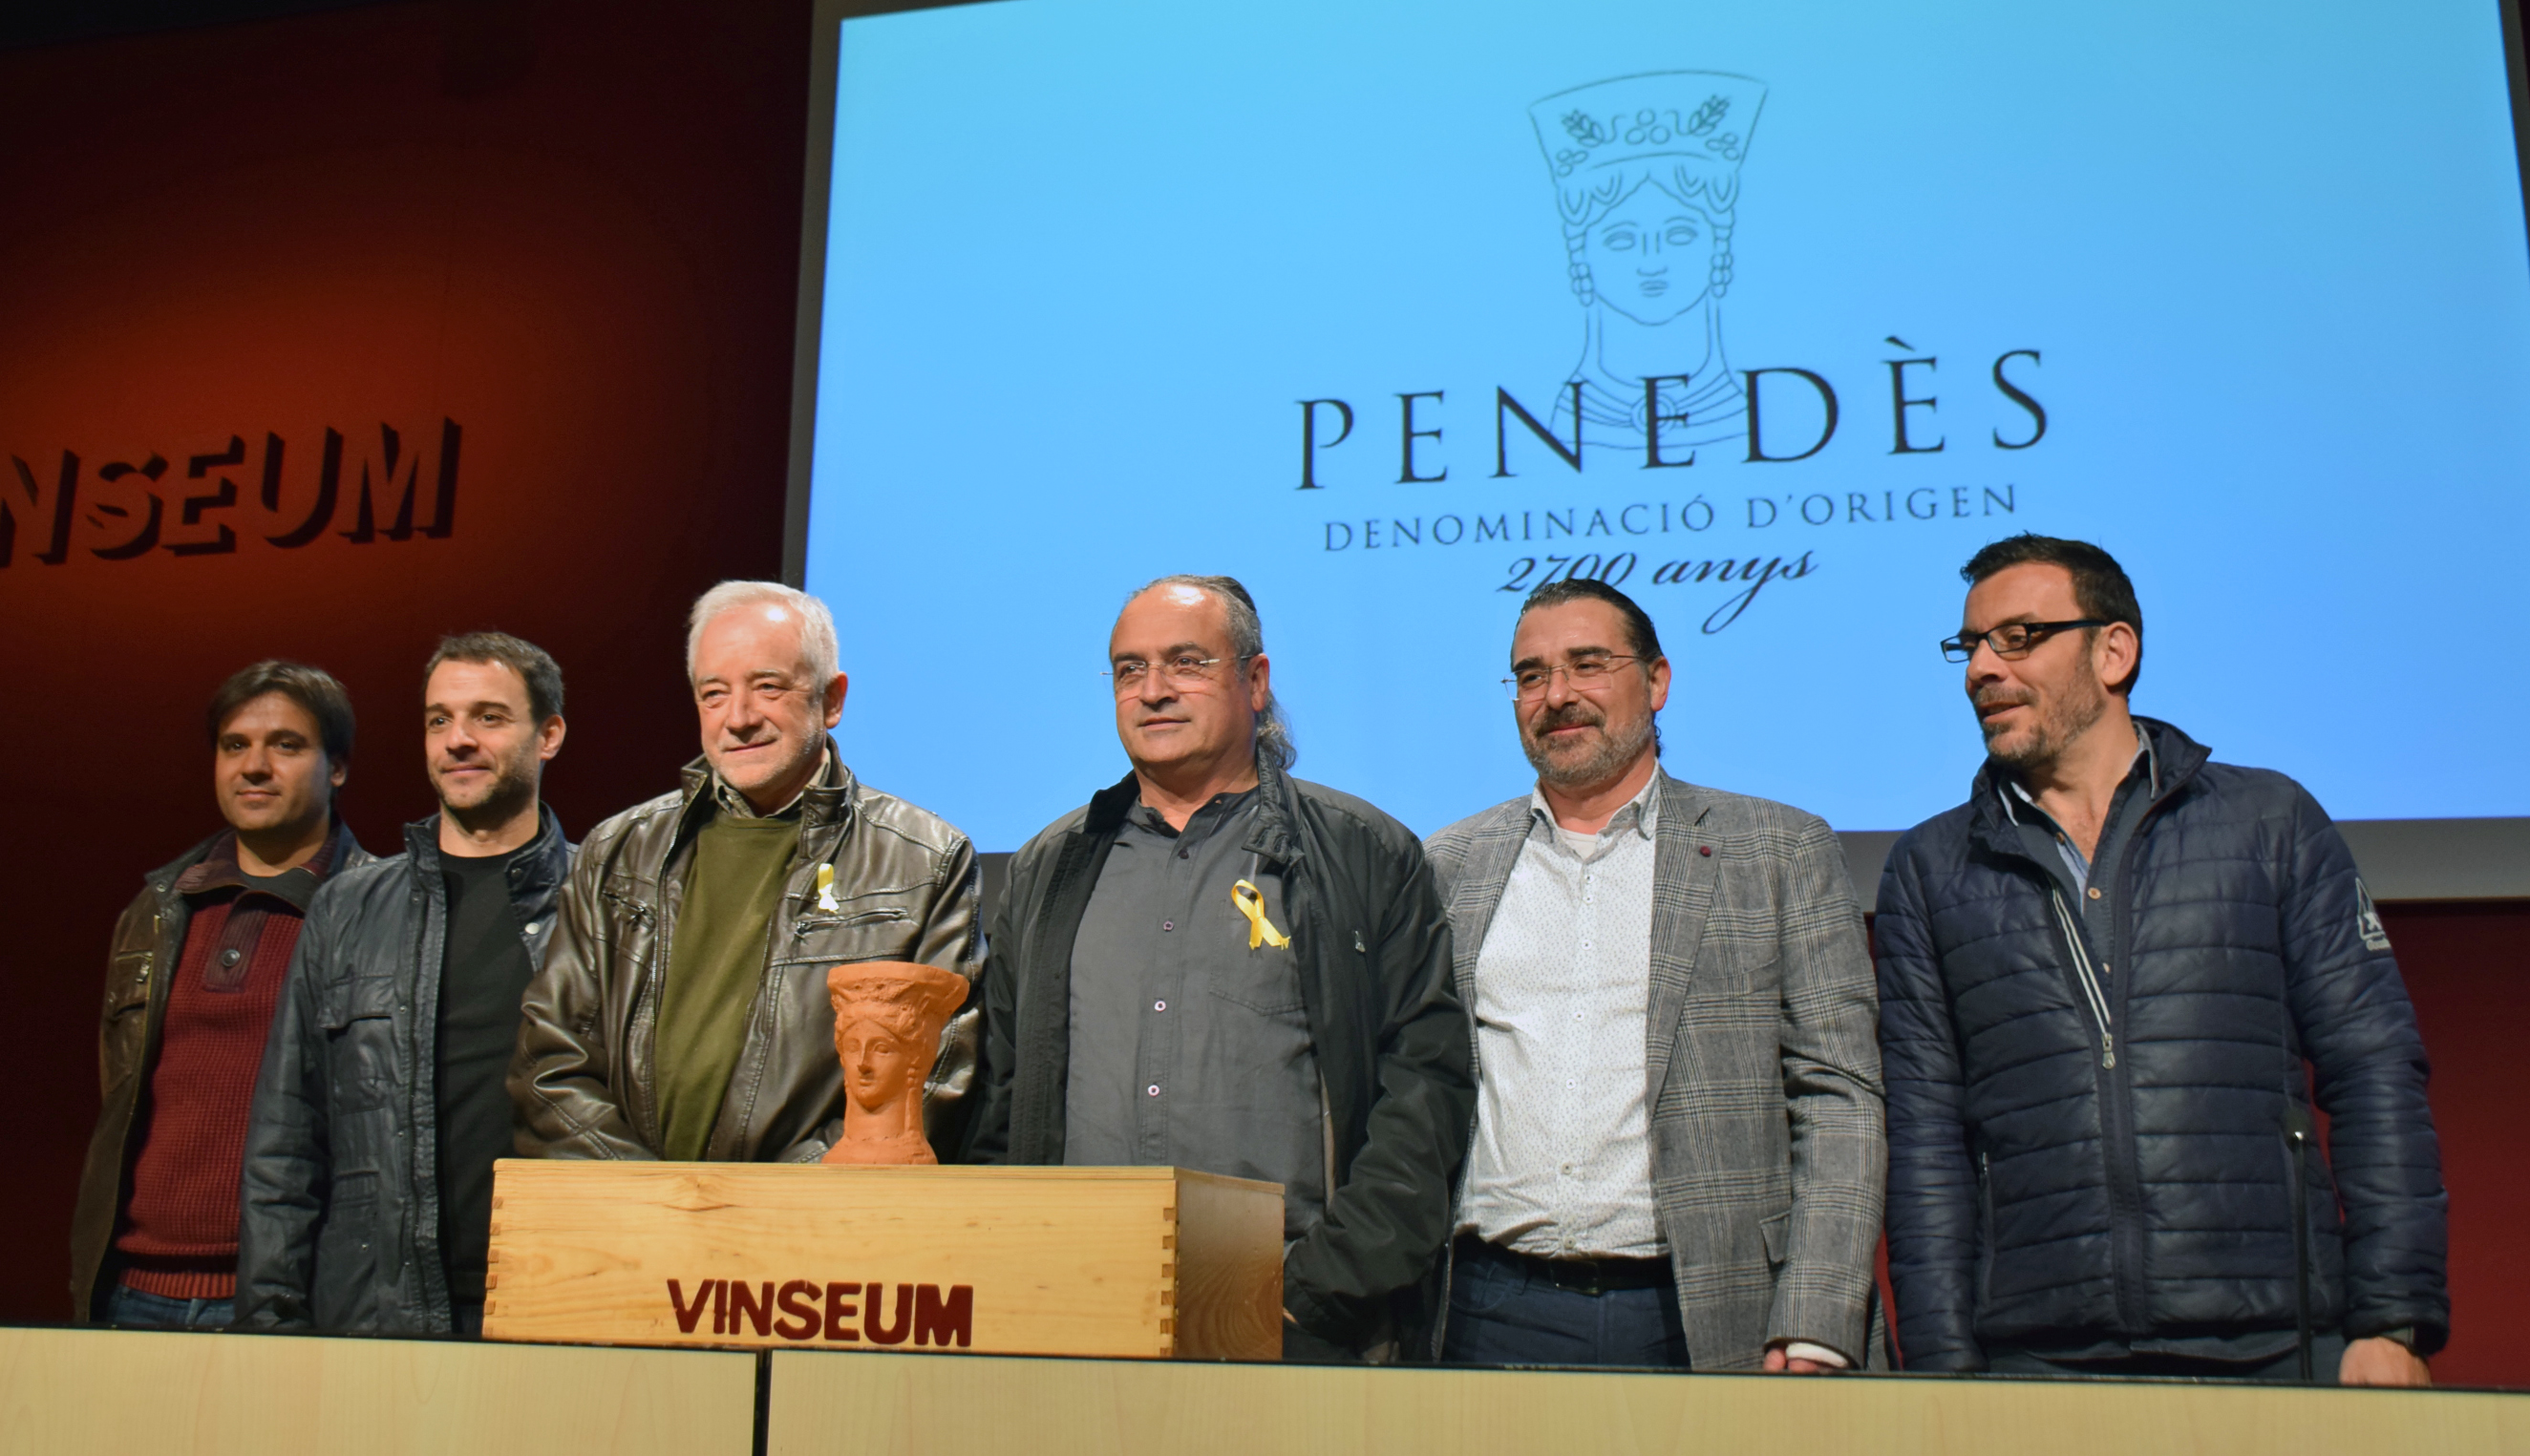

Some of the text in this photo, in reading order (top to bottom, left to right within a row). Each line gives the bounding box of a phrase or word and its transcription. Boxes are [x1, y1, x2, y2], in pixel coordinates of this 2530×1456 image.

[1294, 336, 2048, 491] PENEDÈS
[1323, 485, 2017, 552] DENOMINACIÓ D'ORIGEN
[1497, 550, 1818, 635] 2700 anys
[667, 1278, 974, 1347] VINSEUM
